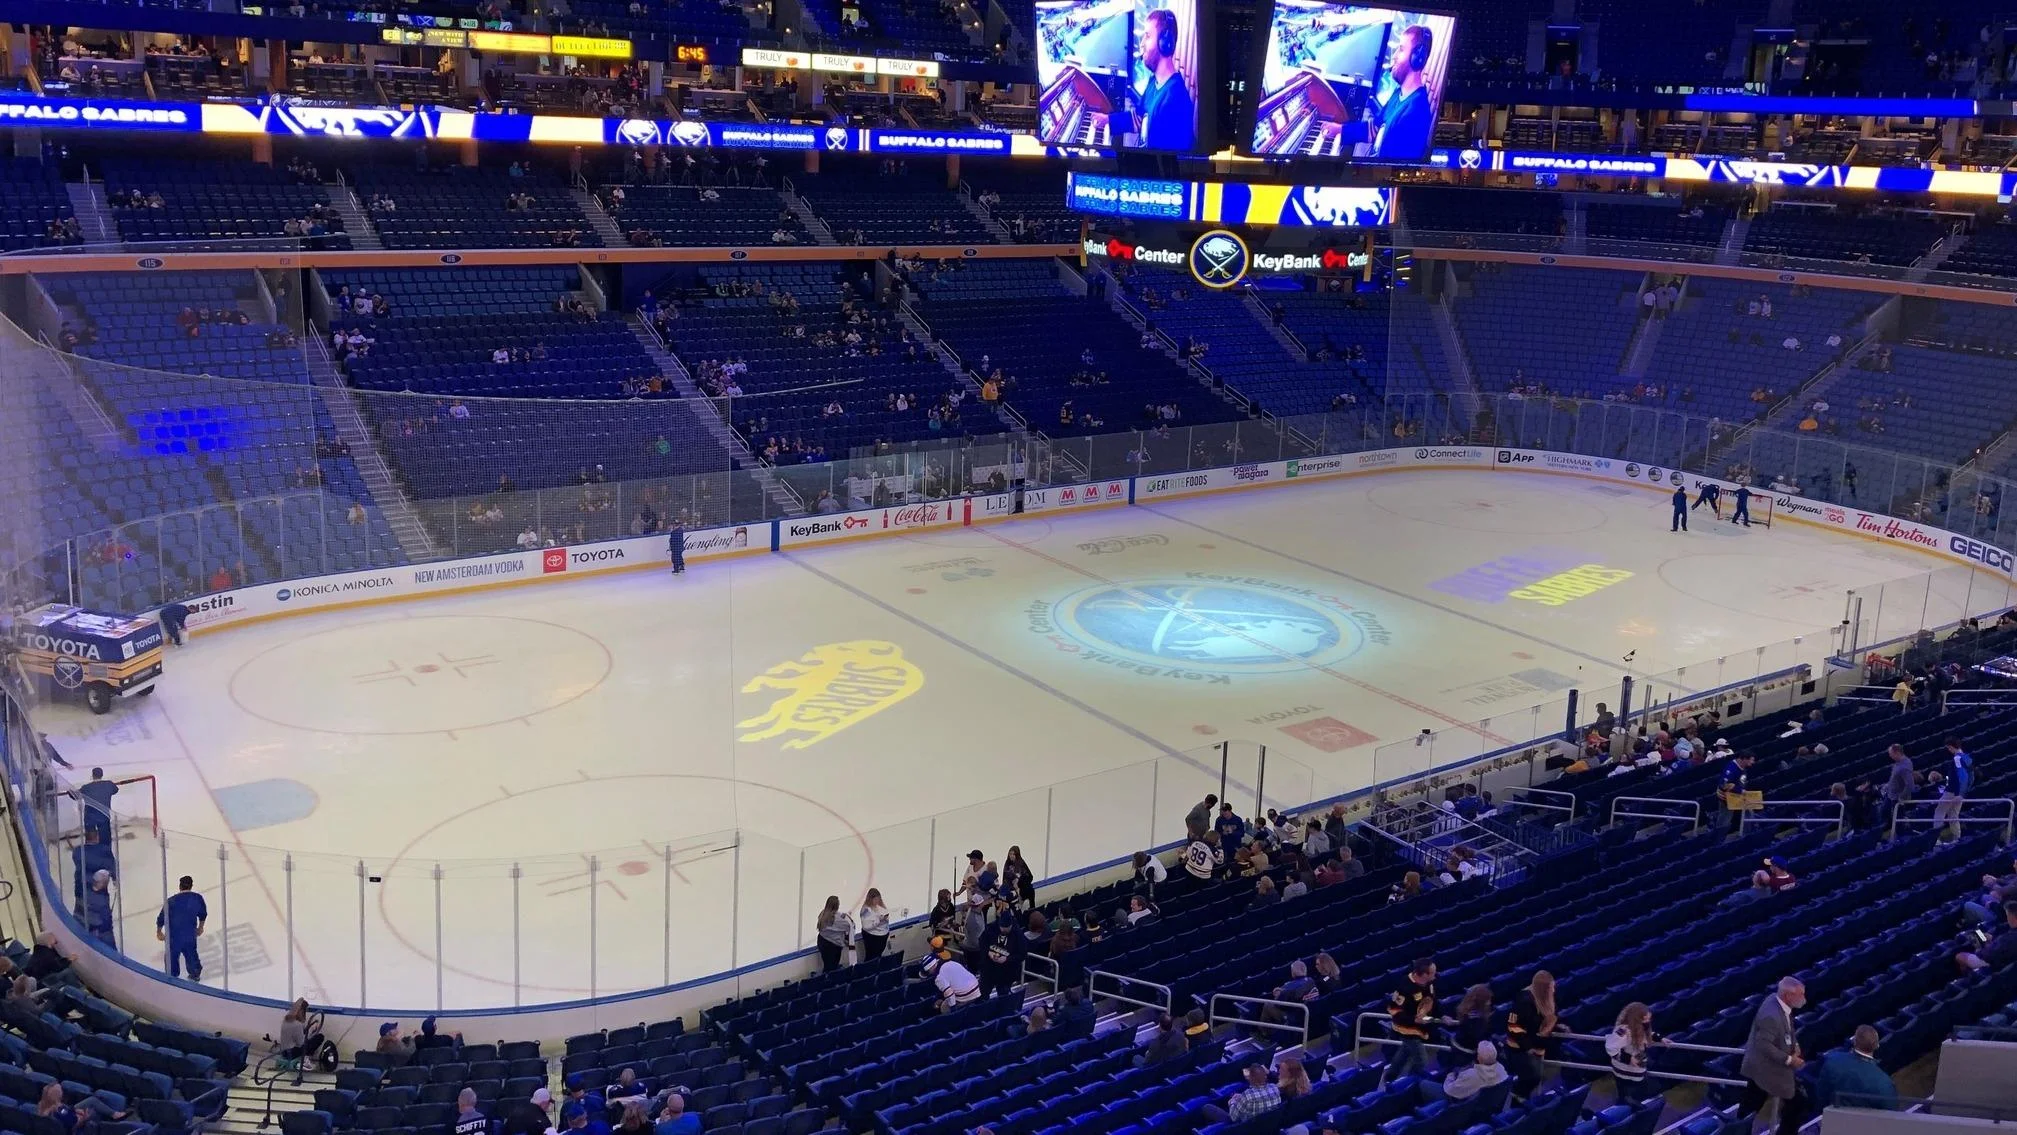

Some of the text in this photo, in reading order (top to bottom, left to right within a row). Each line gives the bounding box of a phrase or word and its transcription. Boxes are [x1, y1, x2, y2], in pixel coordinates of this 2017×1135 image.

[678, 46, 704, 60] 6:45
[755, 51, 782, 62] TRULY
[823, 56, 849, 67] TRULY
[888, 60, 913, 71] TRULY
[81, 107, 187, 123] SABRES
[878, 135, 1003, 149] BUFFALO SABRES
[1513, 156, 1656, 172] BUFFALO SABRES
[1120, 179, 1183, 194] SABRES
[1119, 190, 1183, 205] SABRES
[1119, 201, 1182, 216] SABRES
[1134, 245, 1185, 264] Center
[1253, 253, 1321, 272] KeyBank
[145, 259, 156, 267] 115
[1233, 464, 1259, 475] power
[1548, 456, 1593, 467] HIGHMARK
[1237, 469, 1268, 480] niagara
[1776, 496, 1823, 515] Wegmans
[790, 522, 842, 537] KeyBank
[1856, 513, 1938, 548] Tim Hortons
[572, 548, 624, 564] TOYOTA
[1950, 536, 2012, 573] GEICO
[414, 560, 524, 584] NEW AMSTERDAM VODKA
[293, 577, 394, 598] KONICA MINOLTA
[1185, 571, 1317, 597] KeyBank
[1508, 563, 1636, 606] SABRES
[22, 632, 101, 661] TOYOTA
[135, 633, 161, 649] TOYOTA
[1080, 649, 1232, 686] KeyBank
[791, 661, 907, 726] SABRES
[1245, 703, 1324, 726] TOYOTA
[1191, 847, 1206, 866] 89
[456, 1119, 486, 1134] SCHIFFTY
